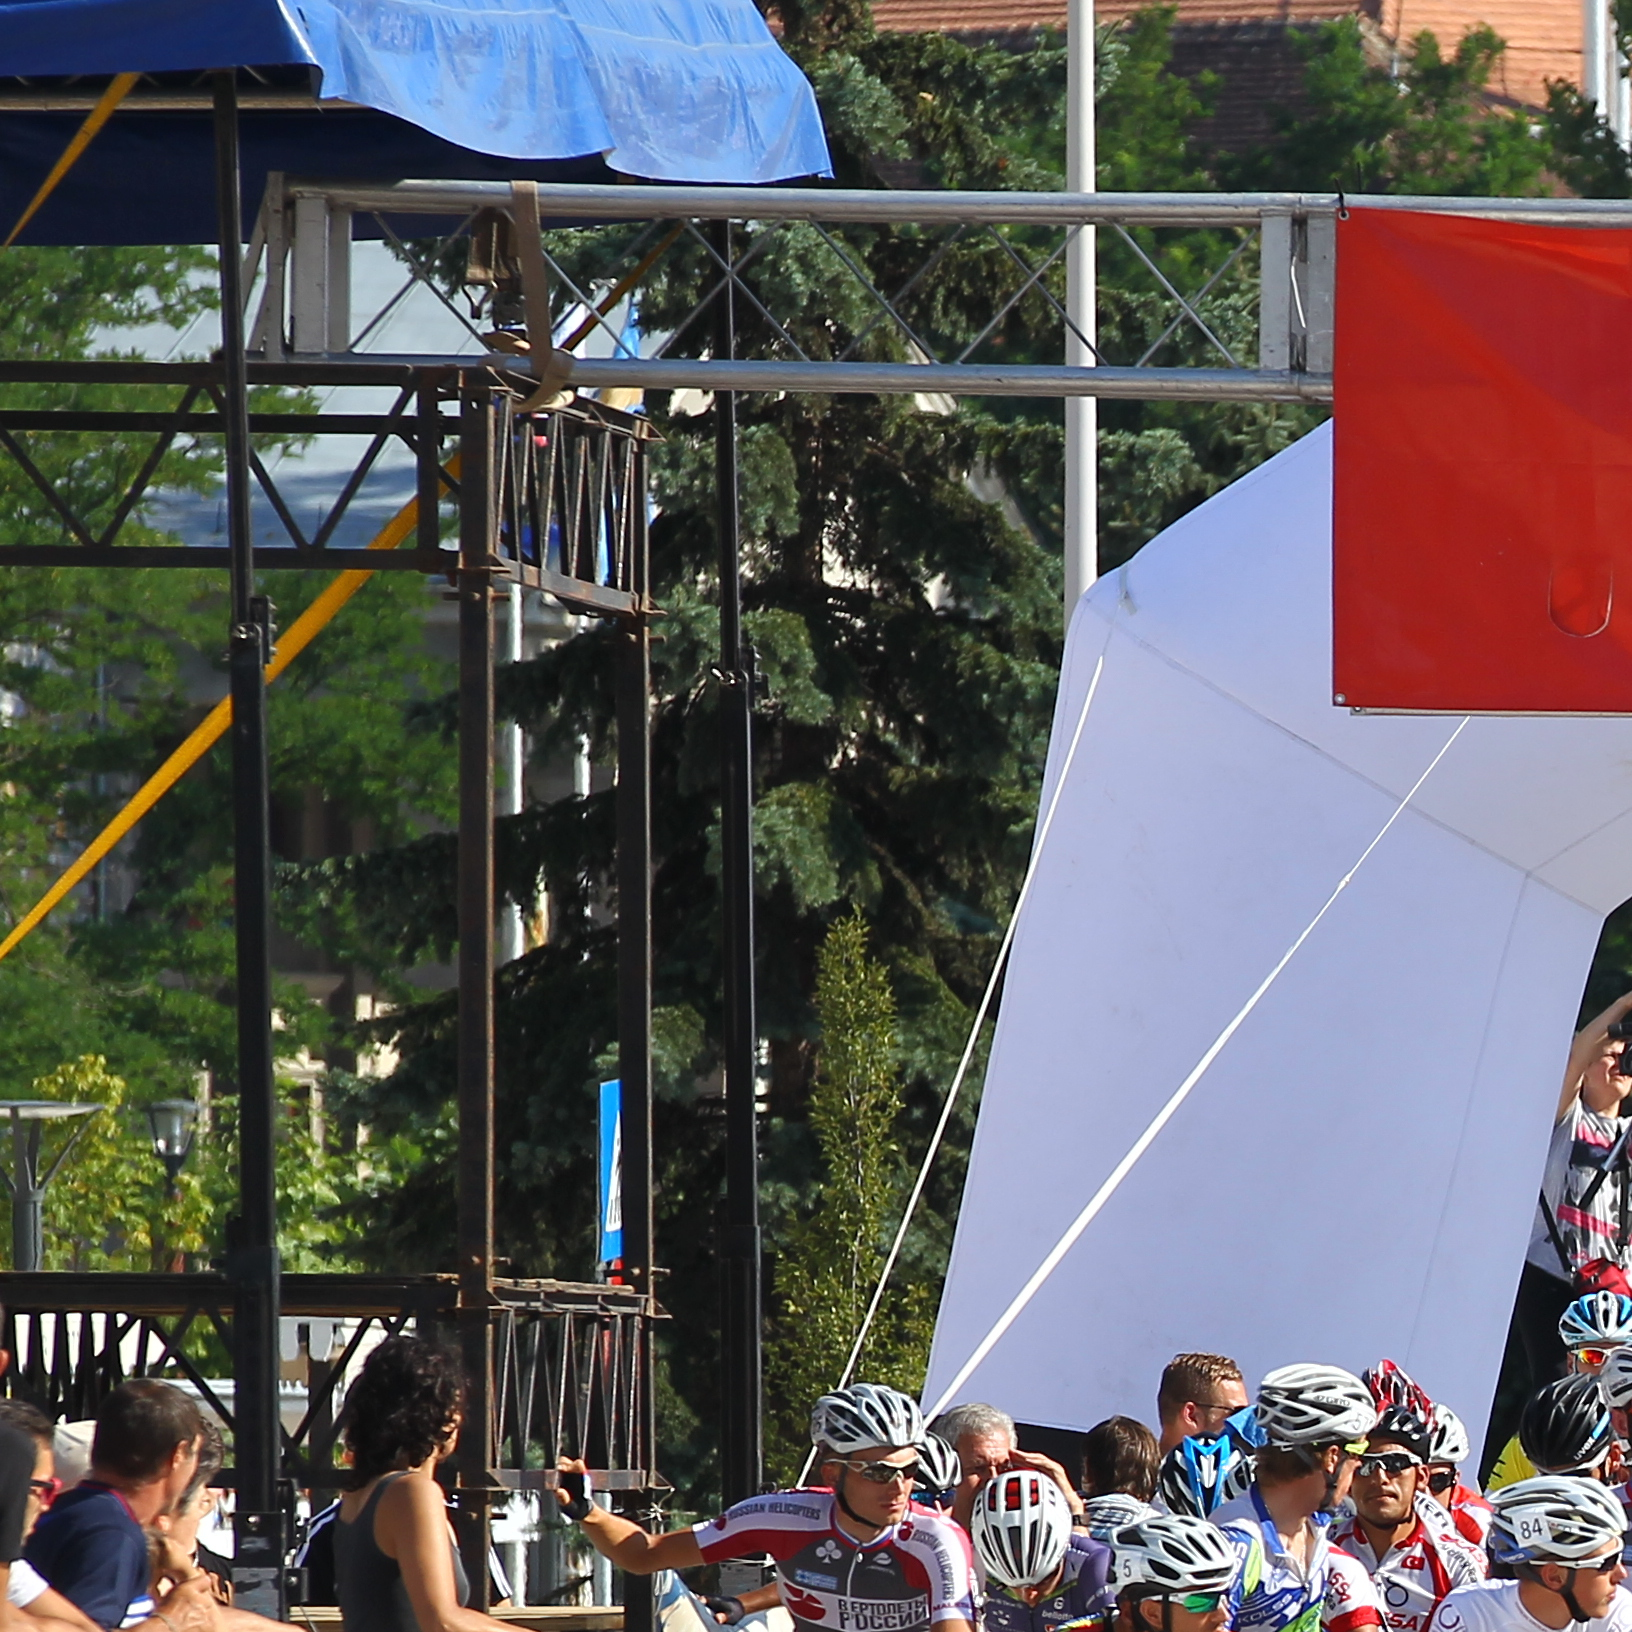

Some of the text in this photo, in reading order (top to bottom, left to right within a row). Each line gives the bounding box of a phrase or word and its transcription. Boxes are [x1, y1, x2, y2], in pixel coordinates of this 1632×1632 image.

[768, 1503, 821, 1520] HELICOPTERS
[1520, 1518, 1543, 1539] 84
[1122, 1558, 1132, 1578] 5
[839, 1609, 928, 1630] РОССИИ
